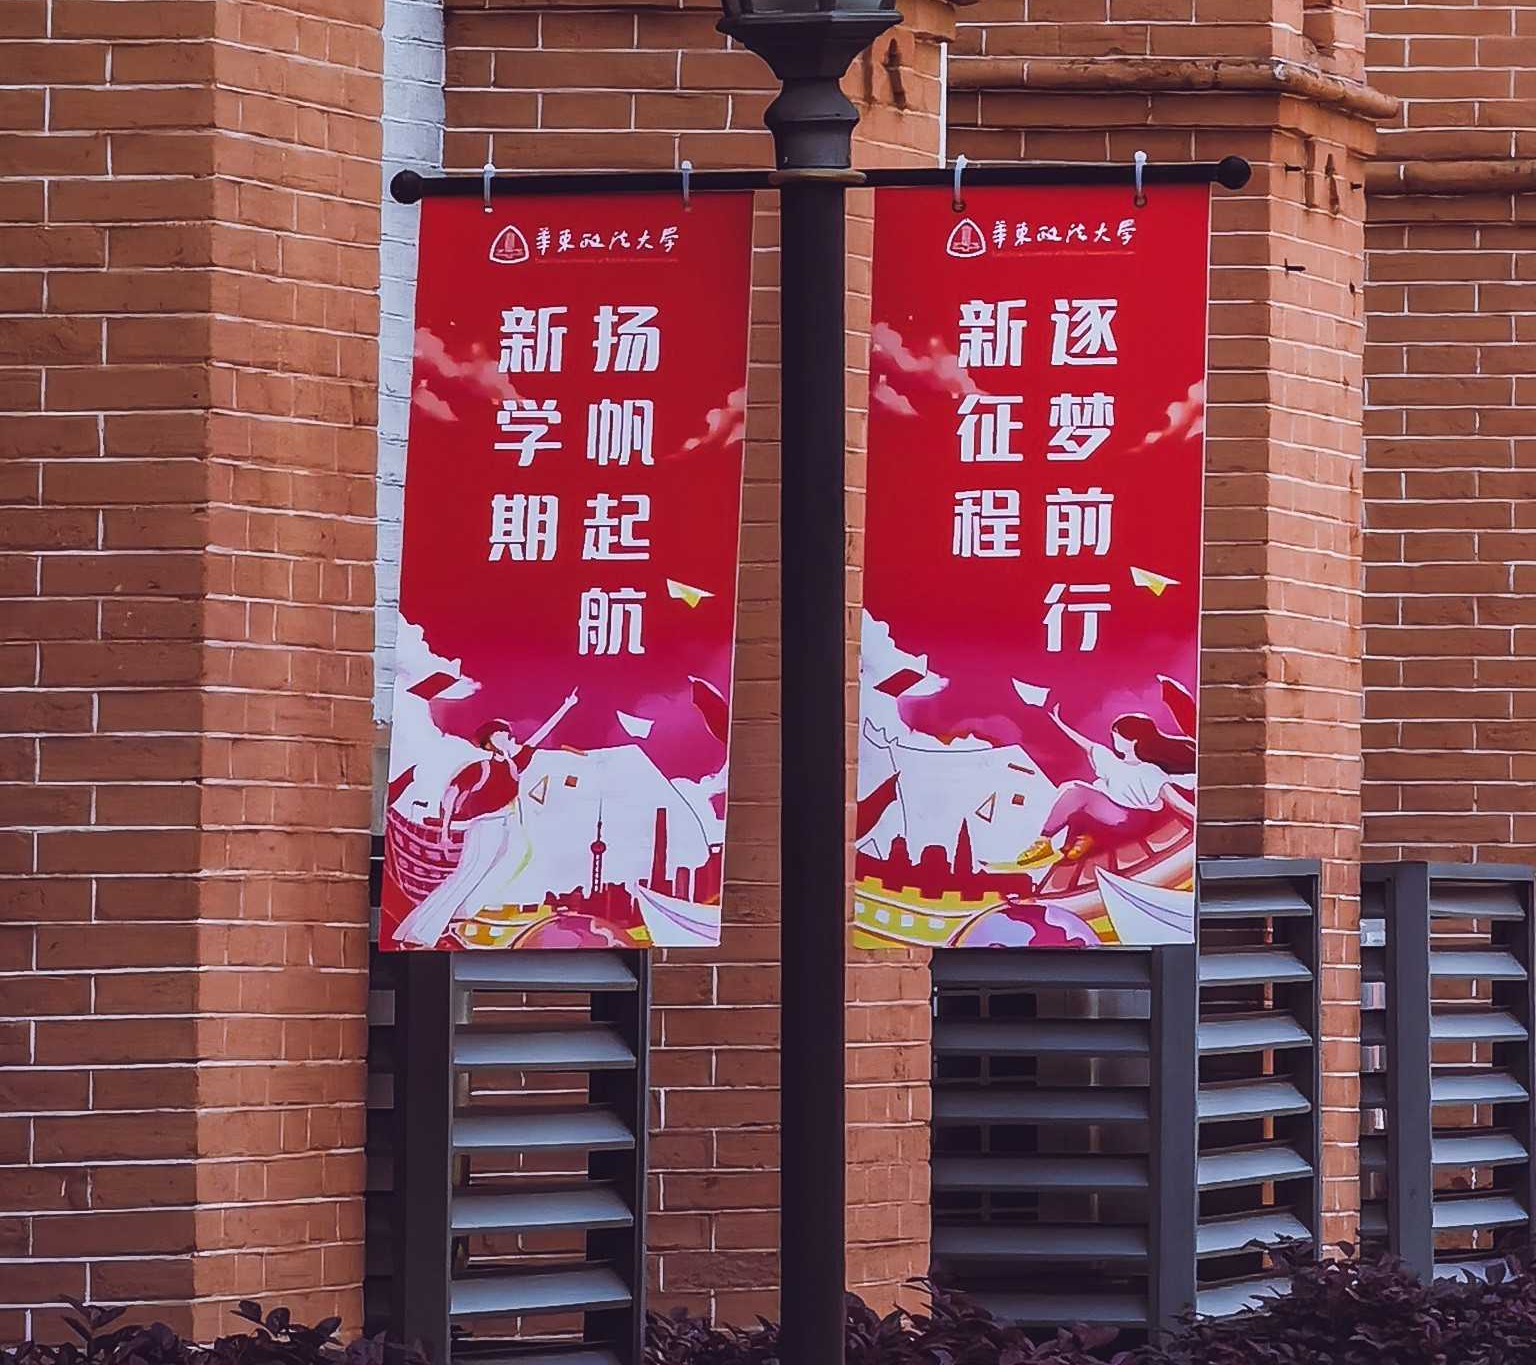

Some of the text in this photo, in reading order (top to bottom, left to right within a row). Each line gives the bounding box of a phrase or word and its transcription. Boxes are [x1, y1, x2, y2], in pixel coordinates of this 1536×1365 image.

[488, 305, 568, 562] 新学期
[578, 305, 660, 655] 扬帆起航
[952, 299, 1027, 558] 新征程
[1042, 298, 1118, 652] 逐梦前行
